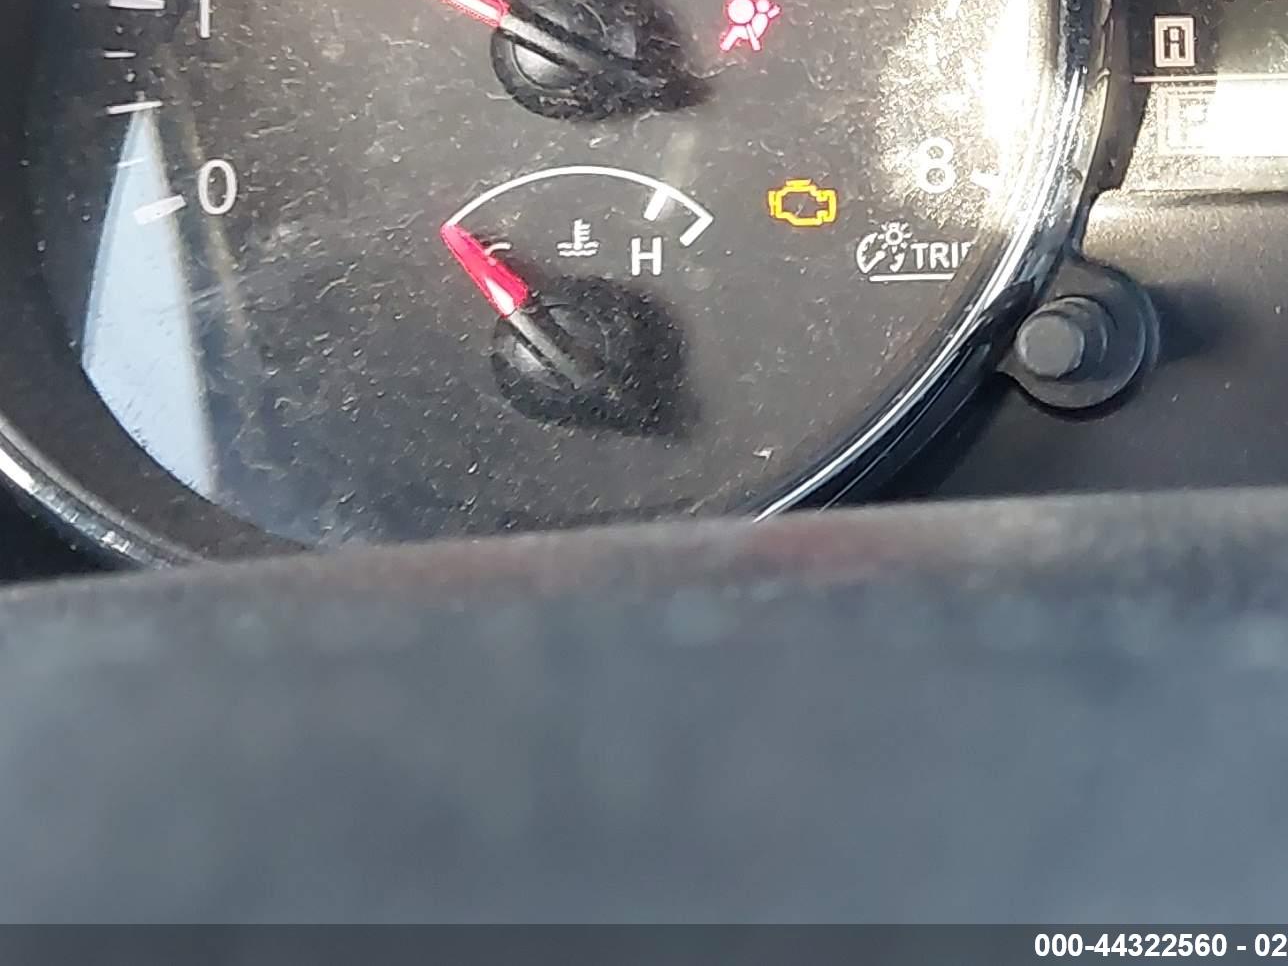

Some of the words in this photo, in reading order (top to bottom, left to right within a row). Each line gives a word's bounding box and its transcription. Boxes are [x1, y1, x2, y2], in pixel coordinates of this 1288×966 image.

[198, 159, 237, 215] 0
[916, 136, 956, 194] 8
[631, 237, 662, 276] H
